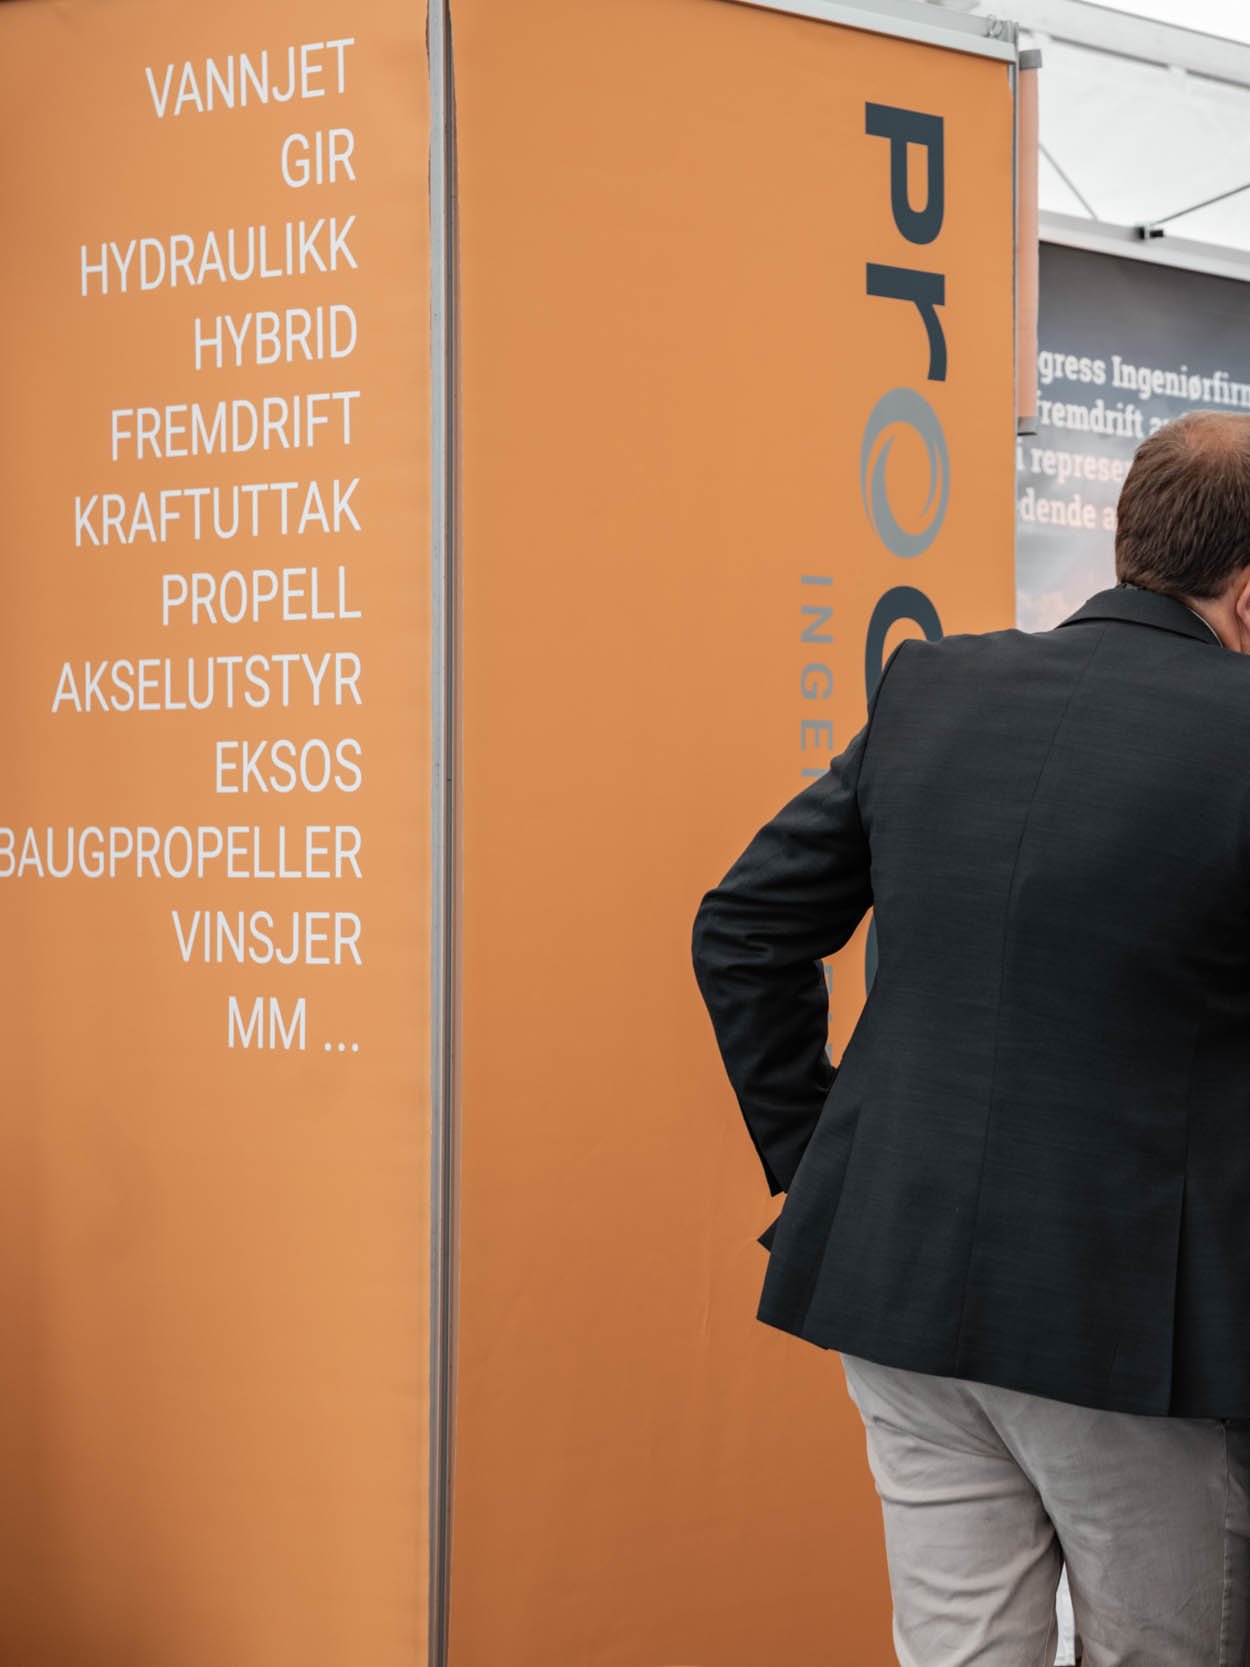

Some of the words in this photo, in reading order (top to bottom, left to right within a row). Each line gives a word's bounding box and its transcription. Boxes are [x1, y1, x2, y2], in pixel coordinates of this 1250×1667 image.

[145, 38, 354, 118] VANNJET
[281, 128, 355, 188] GIR
[81, 215, 358, 297] HYDRAULIKK
[194, 304, 358, 371] HYBRID
[1038, 350, 1106, 385] gress
[111, 391, 361, 461] FREMDRIFT
[1030, 447, 1131, 484] represe
[75, 478, 361, 547] KRAFTUTTAK
[1019, 486, 1096, 529] dende
[162, 566, 362, 626] PROPELL
[52, 652, 363, 712] AKSELUTSTYR
[216, 738, 363, 794] EKSOS
[0, 826, 362, 879] BAUGPROPELLER
[171, 910, 362, 966] VINSJER
[227, 996, 306, 1051] MM
